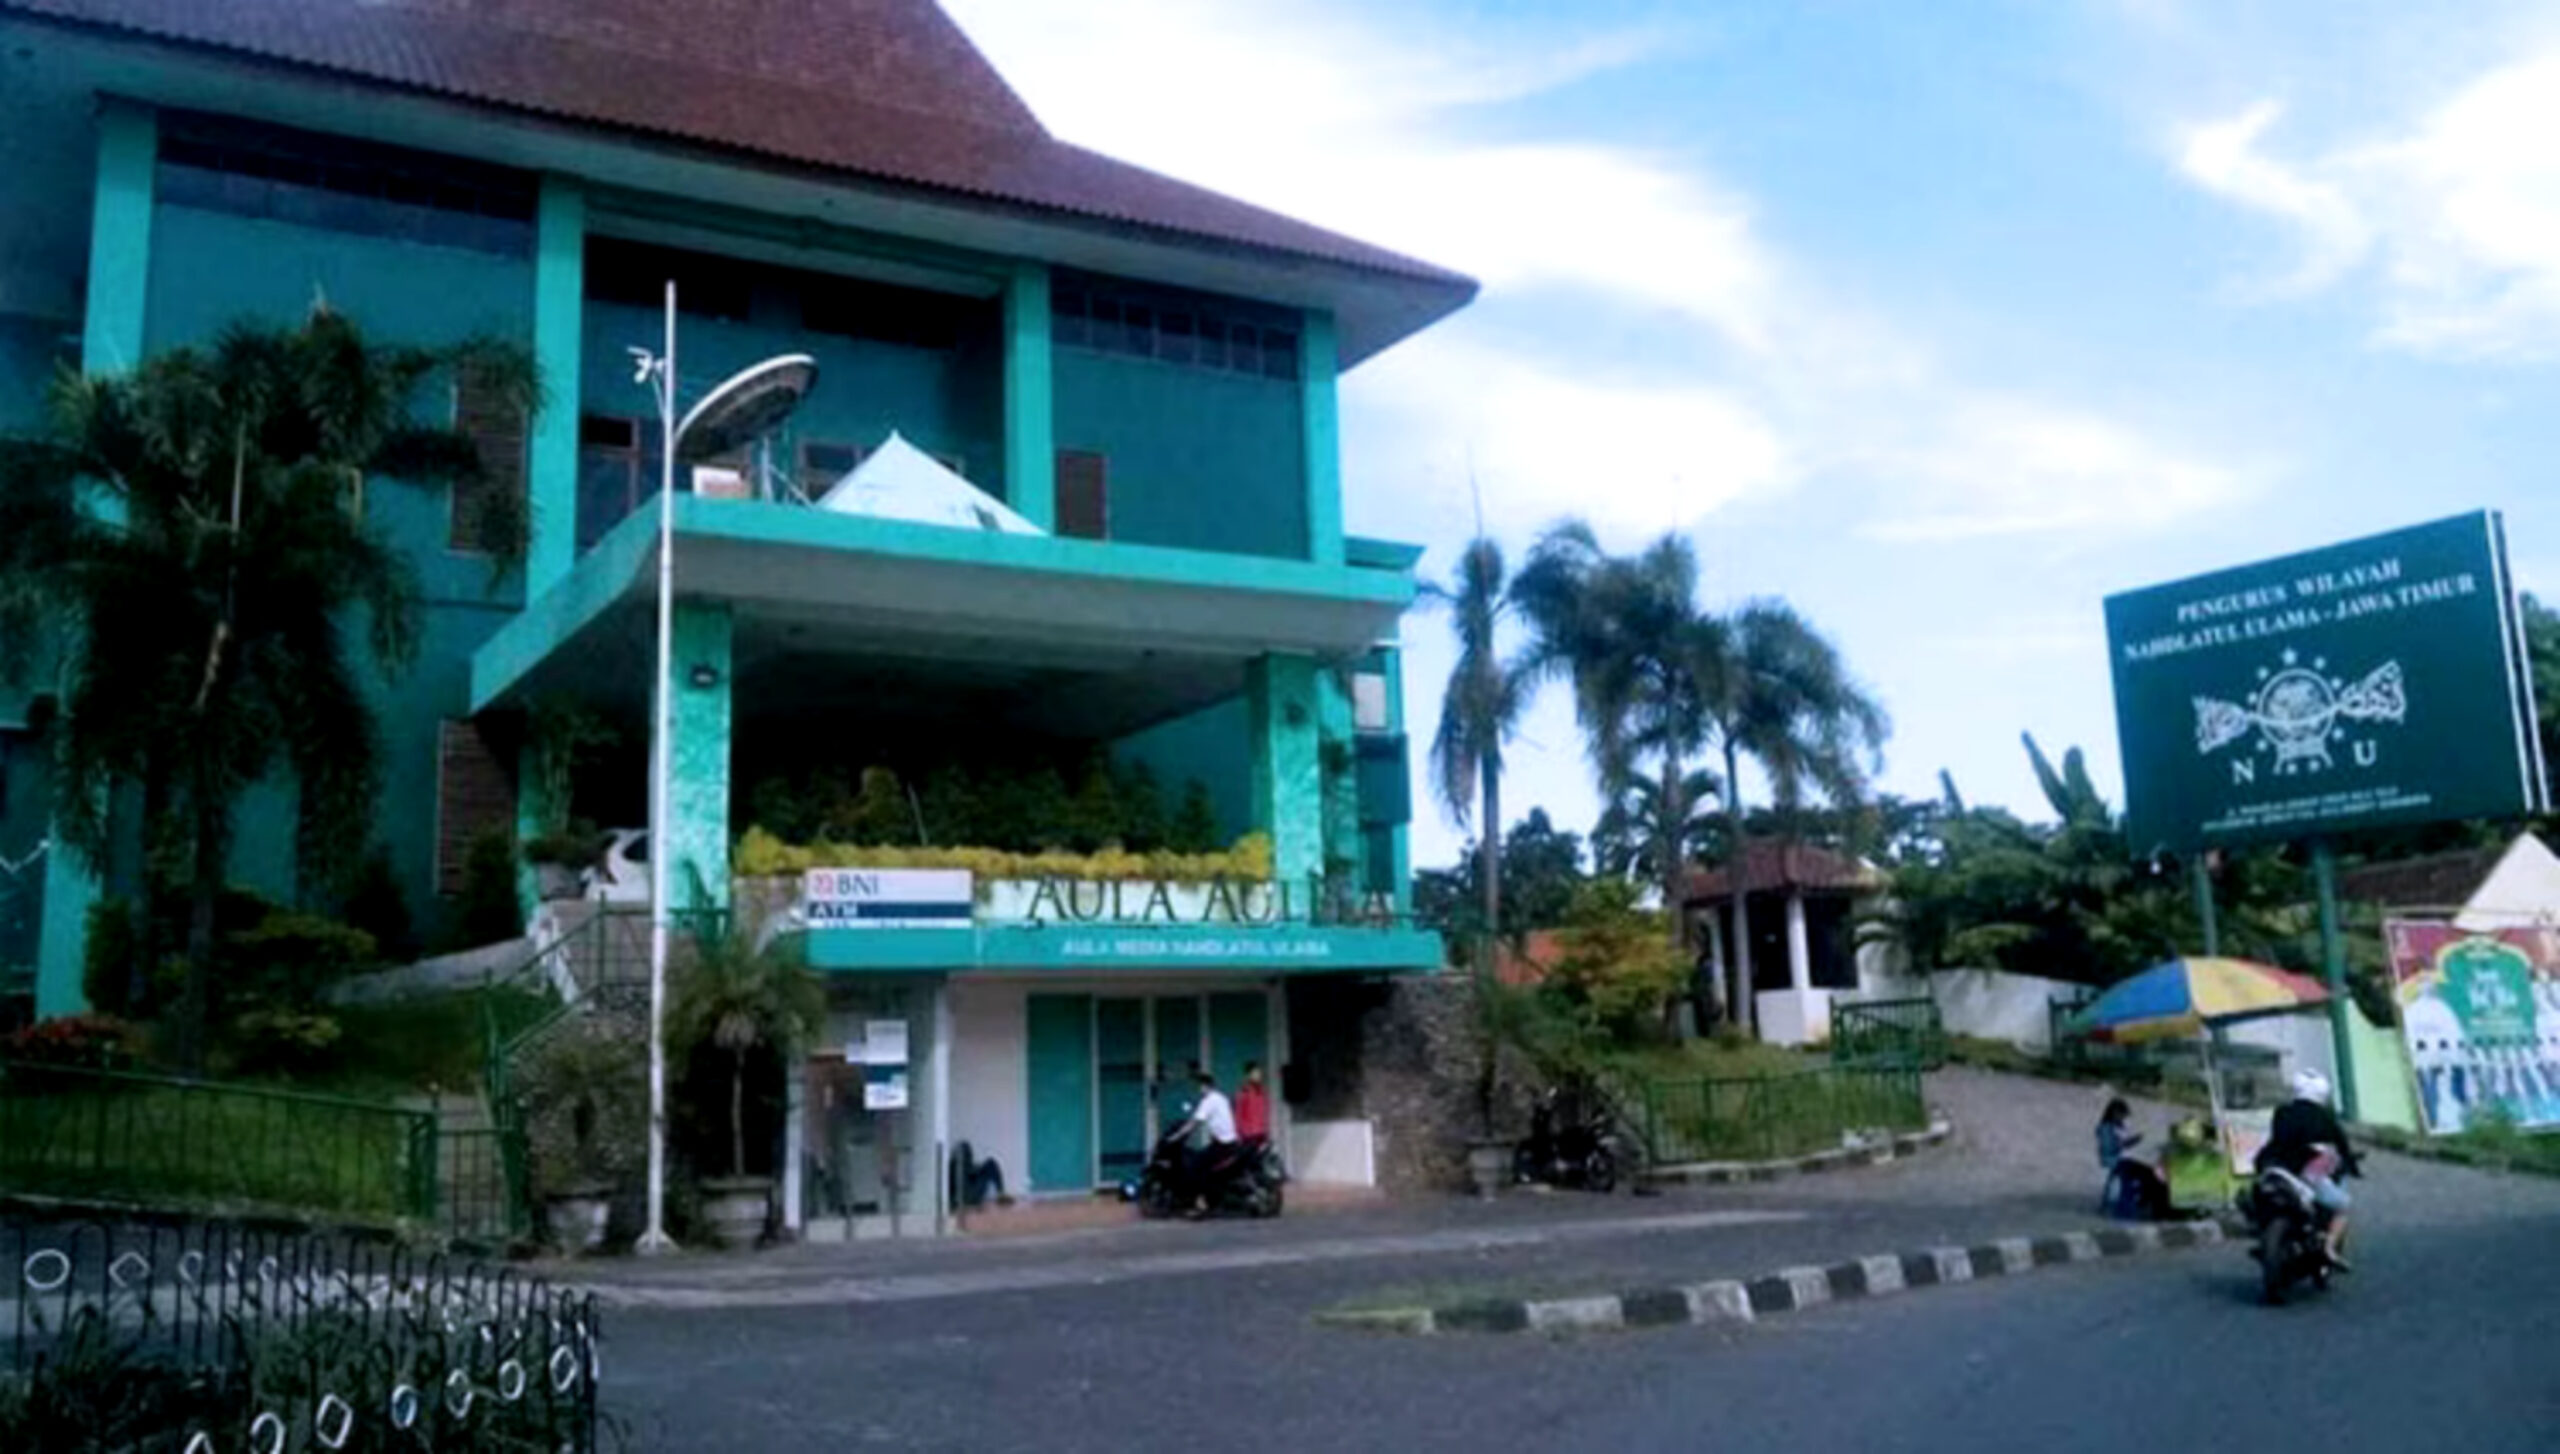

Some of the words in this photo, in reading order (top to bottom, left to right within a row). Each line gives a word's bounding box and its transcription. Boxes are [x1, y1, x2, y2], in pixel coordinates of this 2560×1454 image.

[2177, 585, 2287, 623] PENGURUS
[2296, 558, 2400, 596] WILAYAH
[2243, 607, 2321, 638] ULAMA
[2335, 592, 2395, 620] JAWA
[2397, 573, 2476, 607] TIMUR
[2231, 757, 2255, 785] N
[2353, 739, 2377, 767] U
[837, 873, 879, 896] BNI
[1027, 874, 1179, 922] AULA
